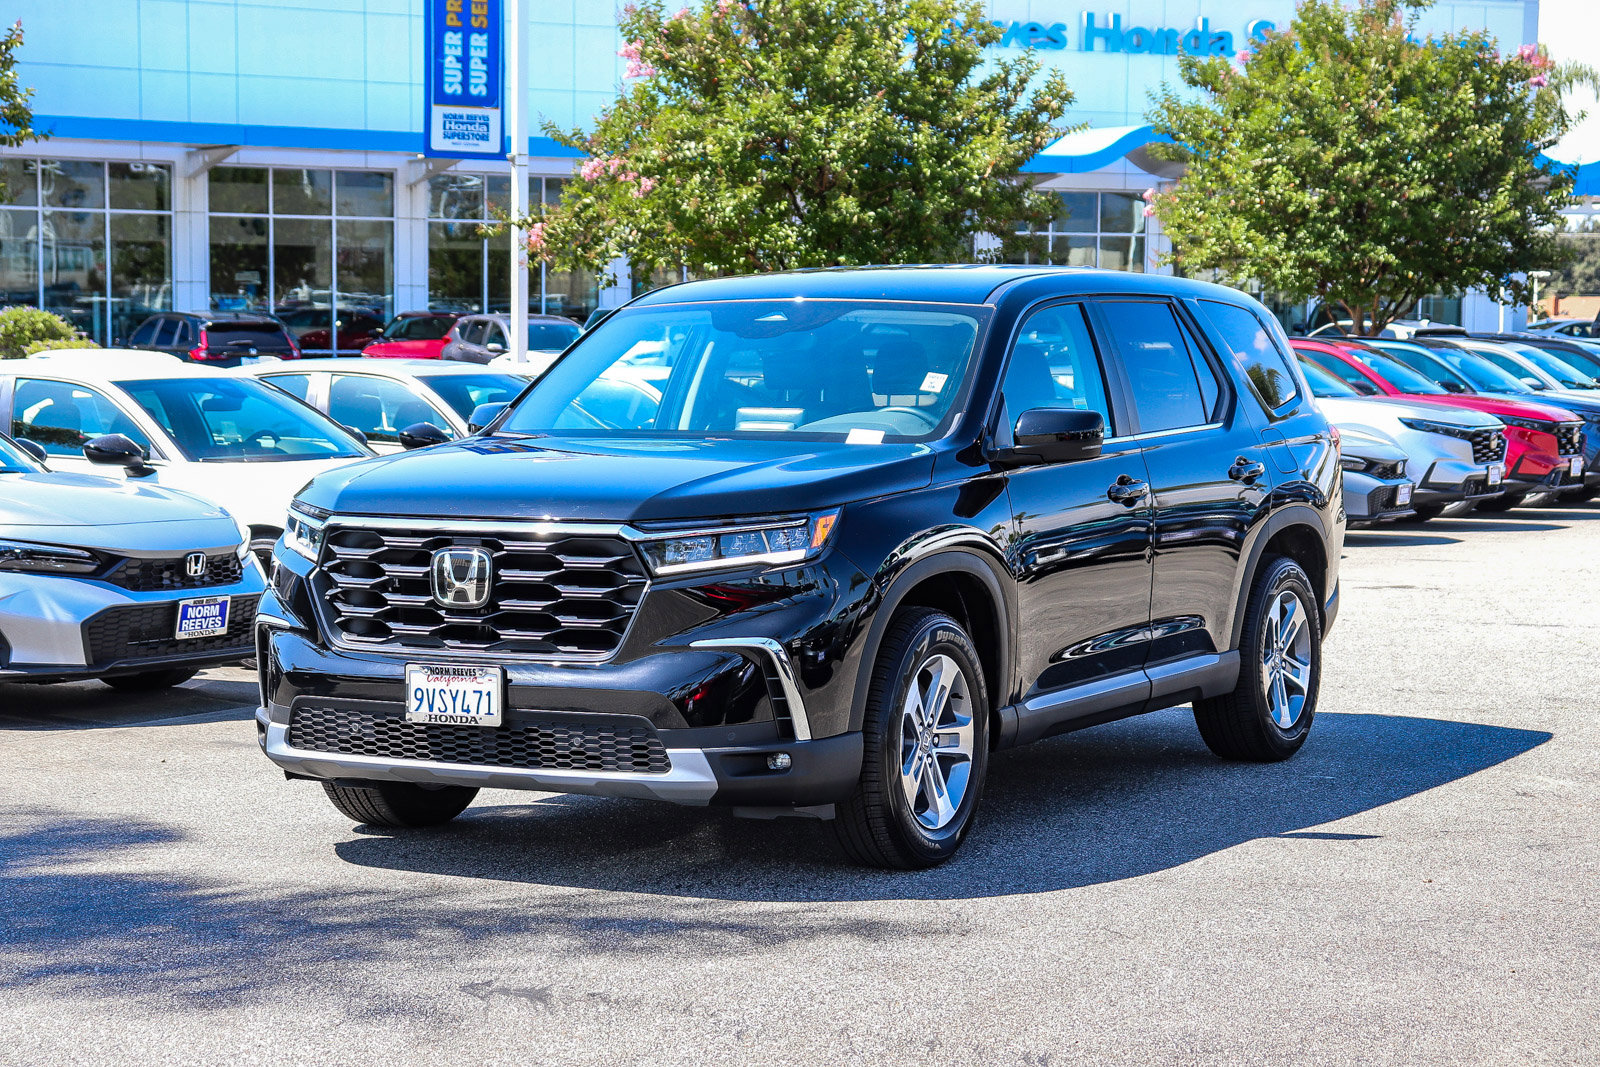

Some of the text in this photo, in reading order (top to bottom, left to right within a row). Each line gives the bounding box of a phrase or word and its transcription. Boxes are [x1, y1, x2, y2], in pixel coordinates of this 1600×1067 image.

[1082, 11, 1236, 56] Honda
[444, 30, 463, 95] SUPER
[469, 32, 488, 97] SUPER
[446, 120, 488, 131] Honda
[443, 131, 489, 141] SUPERSTORE
[187, 604, 220, 619] NORM
[181, 616, 222, 631] REEVES
[187, 629, 216, 638] HONDA
[430, 667, 477, 677] NORM REEVES
[426, 674, 484, 686] California
[414, 687, 494, 715] 9VSY471
[428, 714, 479, 725] HONDA
